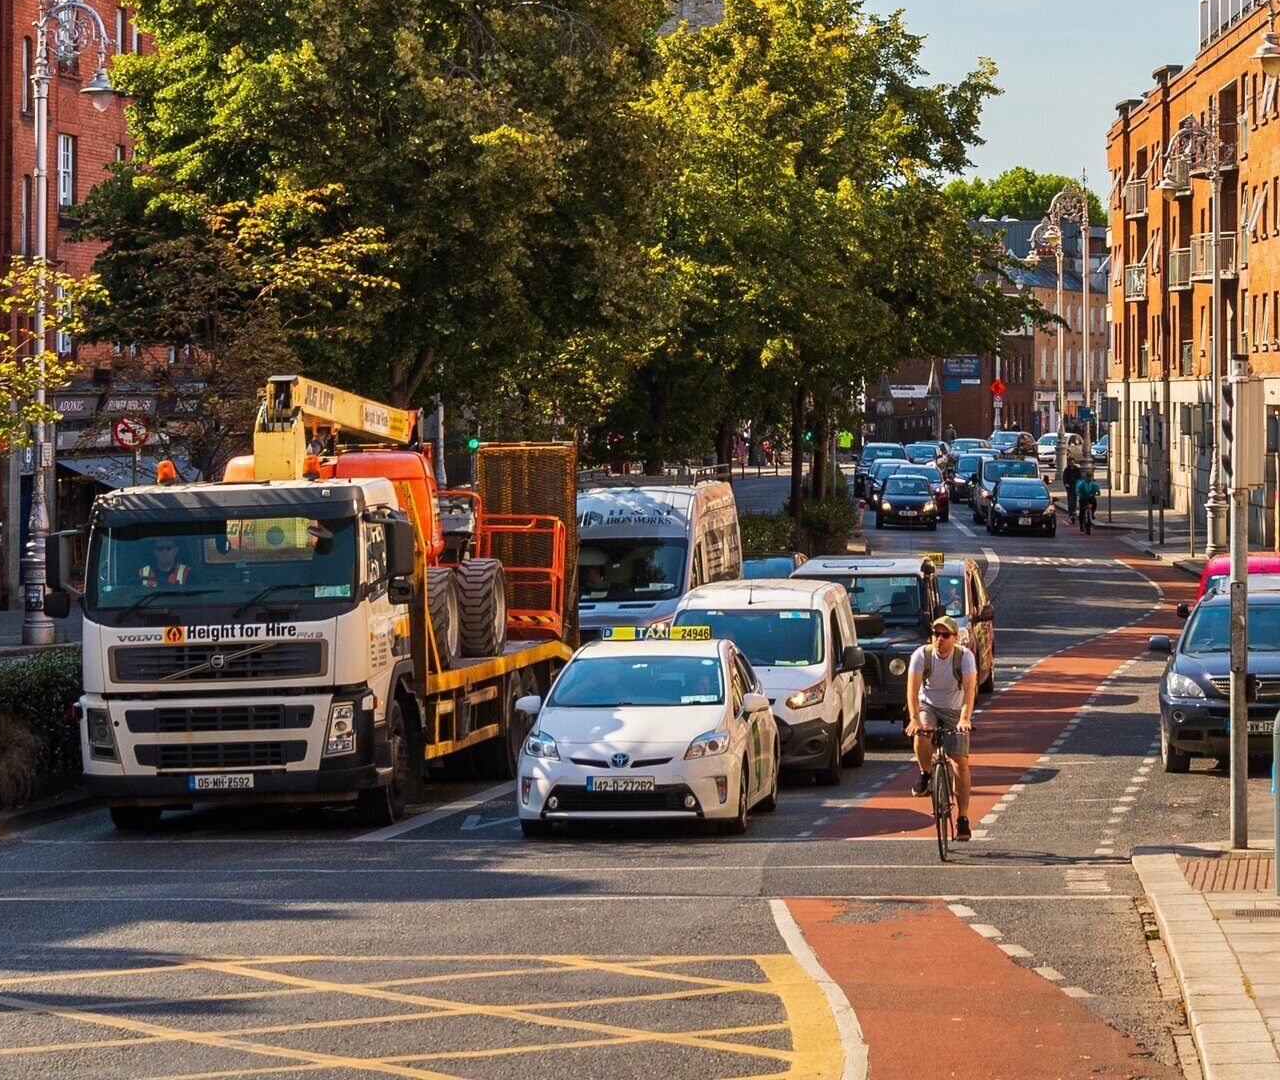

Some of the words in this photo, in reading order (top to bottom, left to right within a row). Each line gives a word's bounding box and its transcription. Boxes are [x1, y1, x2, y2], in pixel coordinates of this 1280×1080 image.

[59, 400, 84, 412] ADONIS
[319, 388, 335, 414] LIFT
[606, 515, 673, 526] IRONWORKS
[116, 633, 163, 643] VOLVO
[186, 625, 236, 642] Height
[239, 624, 260, 638] for
[265, 623, 297, 637] Hire
[296, 631, 324, 640] FM9
[603, 627, 613, 639] D
[637, 627, 669, 639] TAXI
[681, 628, 710, 639] 24946
[594, 780, 653, 792] 142-D-27262
